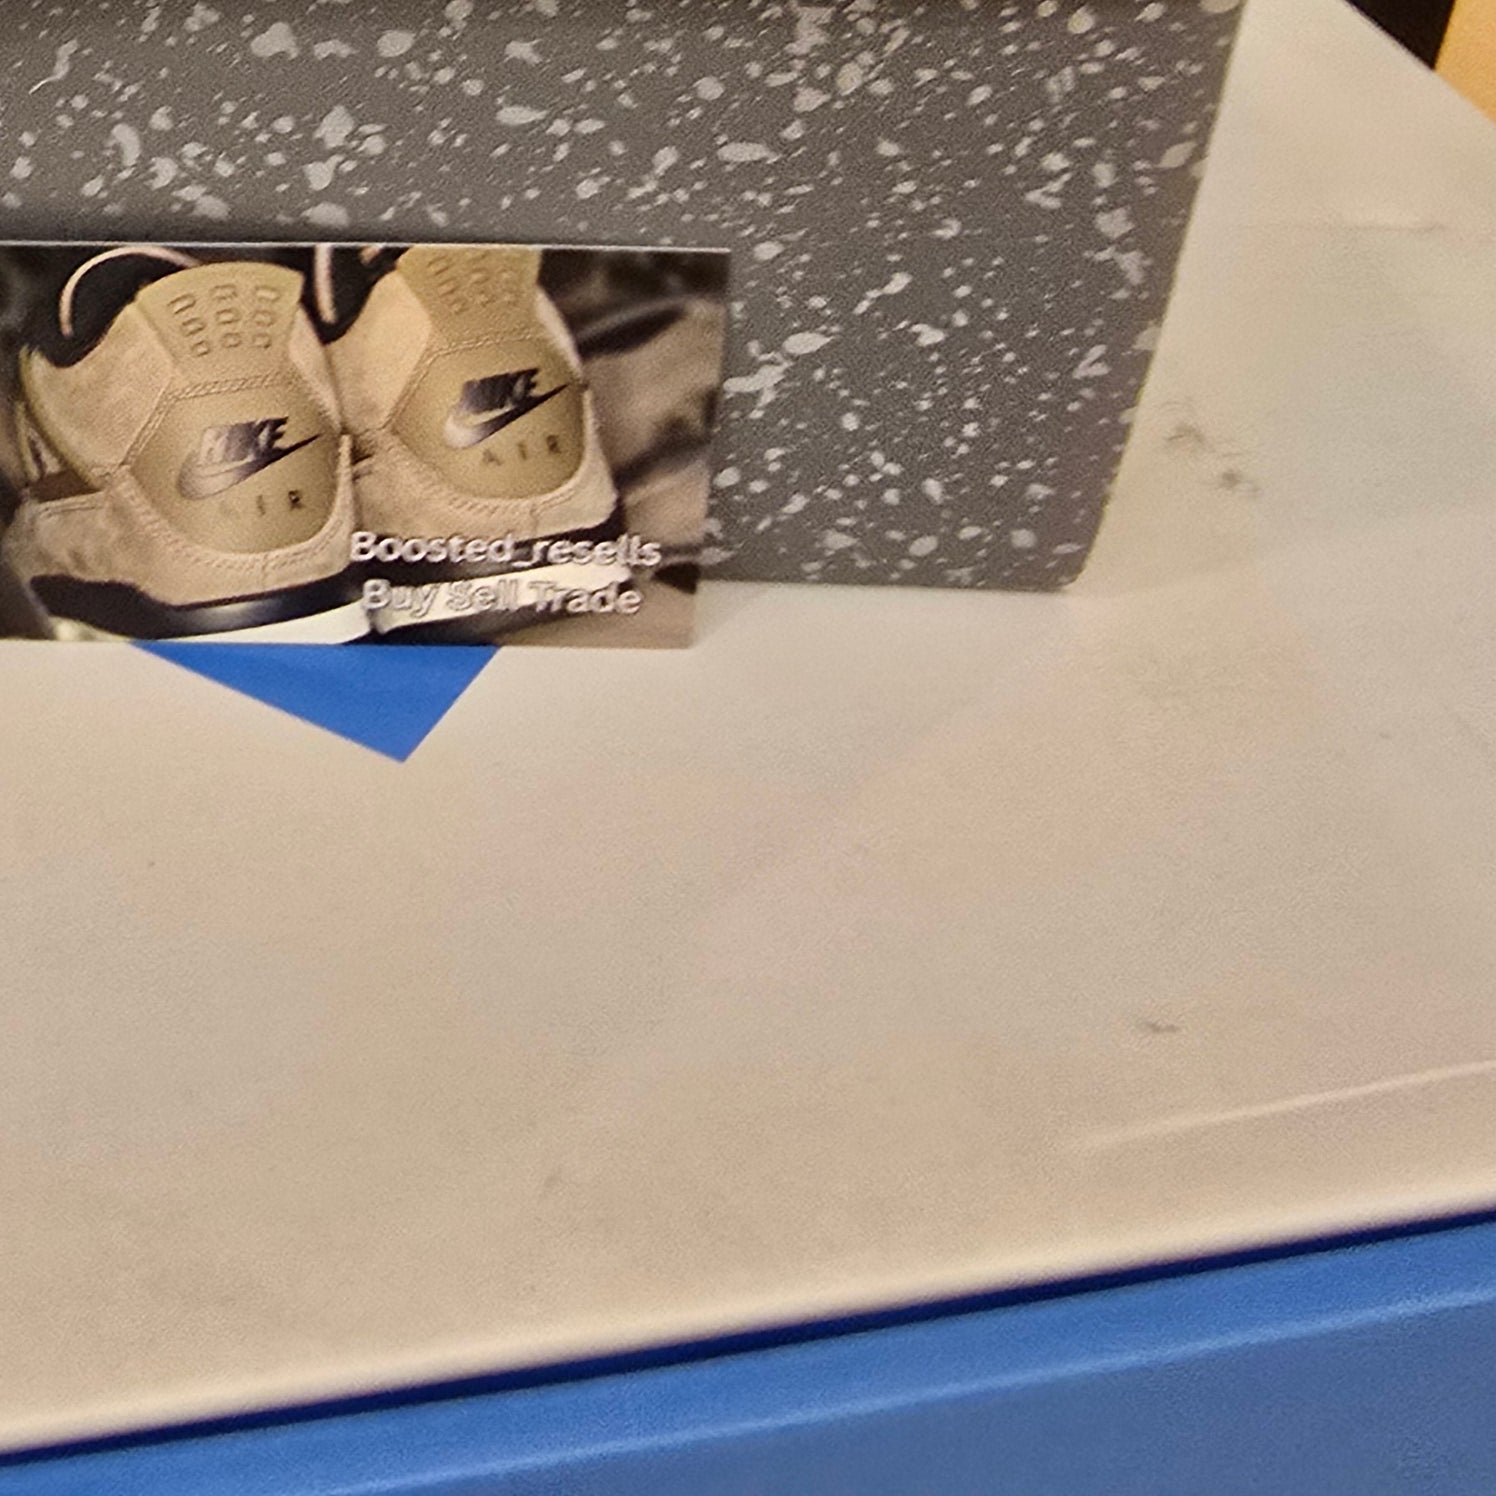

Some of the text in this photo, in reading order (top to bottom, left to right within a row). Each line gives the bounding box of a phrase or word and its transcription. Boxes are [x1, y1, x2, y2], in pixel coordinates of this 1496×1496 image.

[462, 368, 539, 415] NIKE
[199, 416, 290, 466] NIKE
[482, 435, 563, 467] AIR
[349, 530, 663, 569] Boosted_resells
[361, 578, 643, 618] Buy Sell Trade
